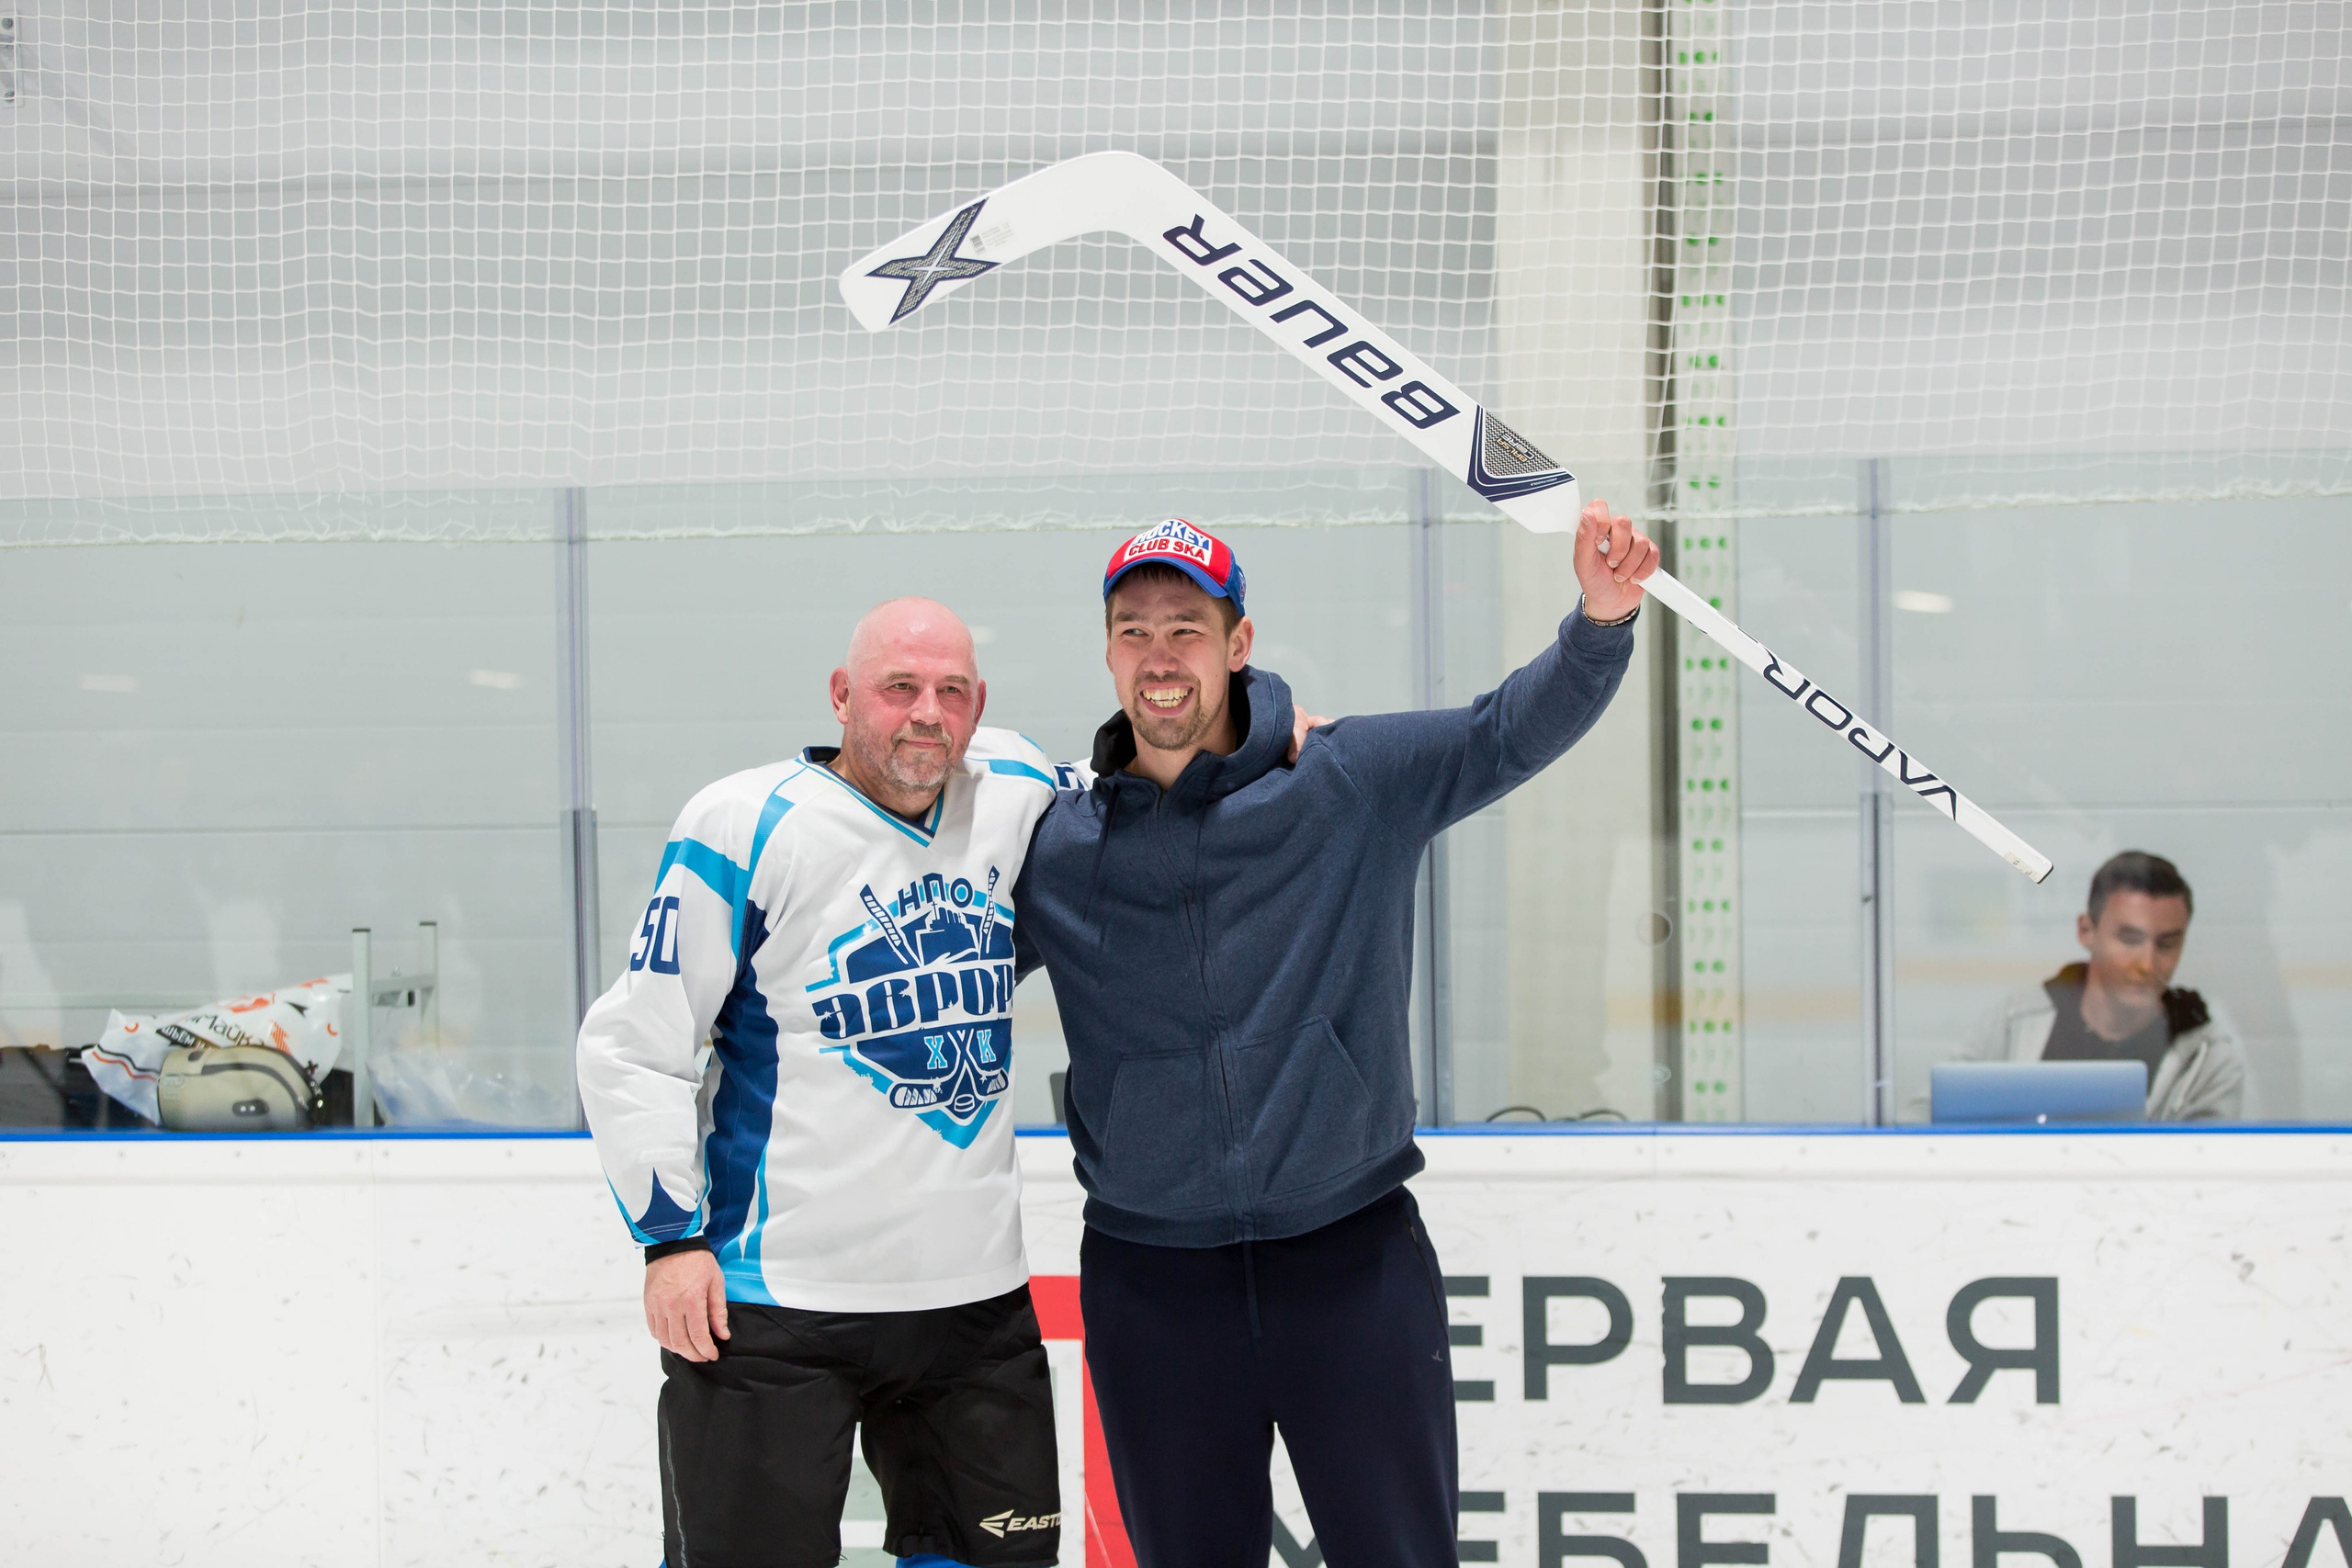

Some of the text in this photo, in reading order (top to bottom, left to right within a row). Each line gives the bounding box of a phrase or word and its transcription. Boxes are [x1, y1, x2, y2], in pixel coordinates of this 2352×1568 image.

[1162, 213, 1461, 429] BAUER
[1498, 438, 1527, 462] BALSA
[1500, 434, 1535, 459] CORE
[1129, 538, 1204, 561] CLUB SKA
[1132, 521, 1209, 548] HOCKEY
[1762, 645, 1956, 821] VAPOR
[898, 873, 973, 918] НПО
[630, 896, 680, 975] 50
[924, 1029, 996, 1070] Х К
